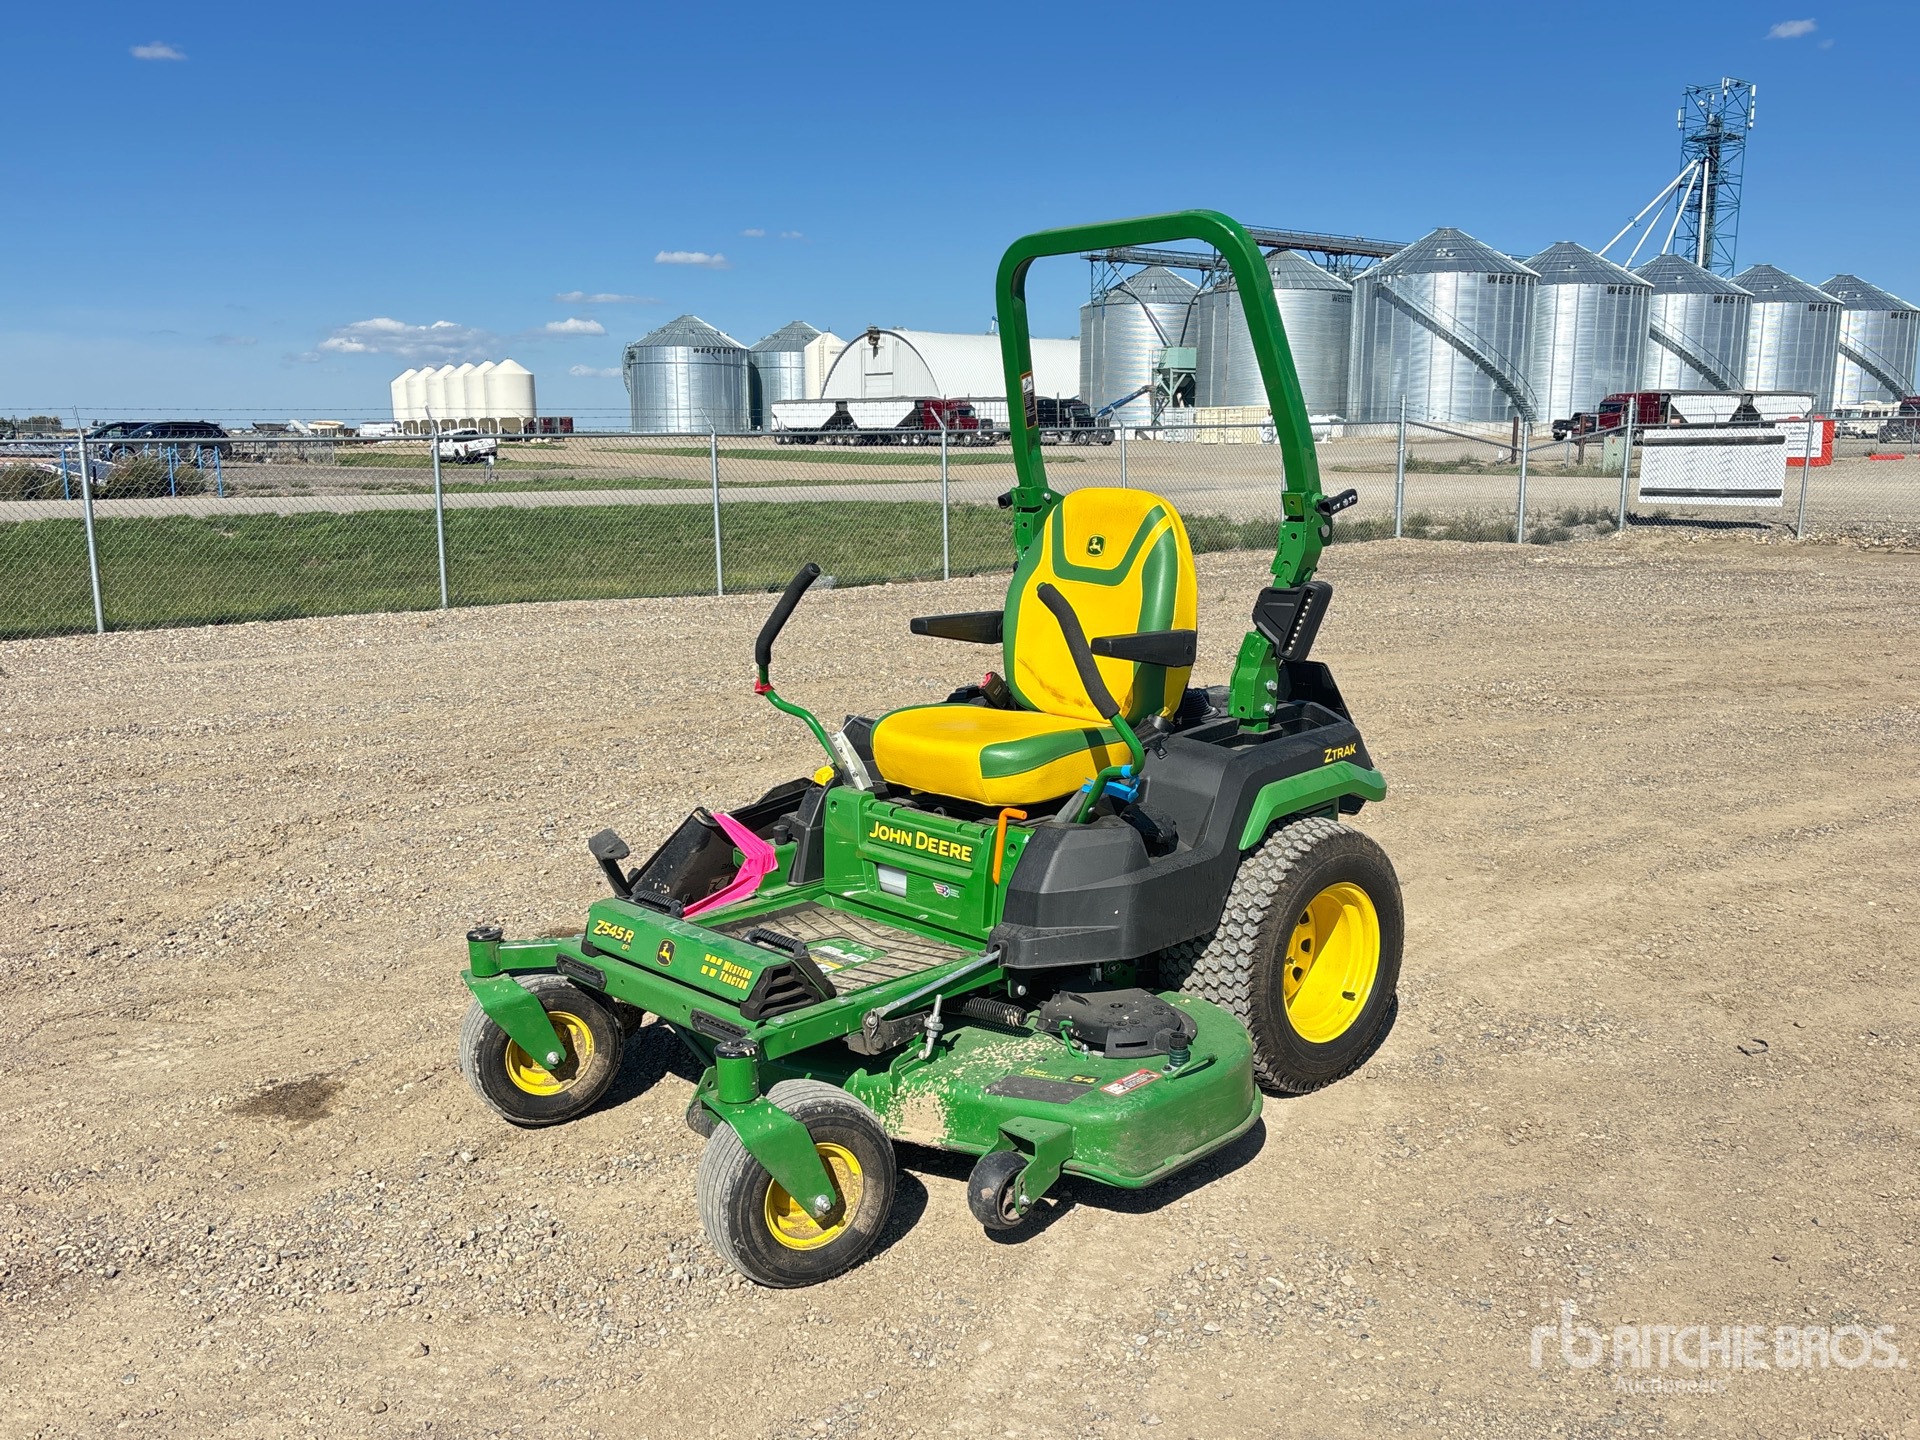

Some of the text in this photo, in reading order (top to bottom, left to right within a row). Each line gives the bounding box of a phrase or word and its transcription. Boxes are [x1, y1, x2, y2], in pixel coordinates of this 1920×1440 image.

[1324, 742, 1357, 764] ZTRAK
[869, 821, 973, 863] JOHN DEERE
[718, 970, 749, 990] TRACTOR
[722, 960, 753, 980] WESTERN
